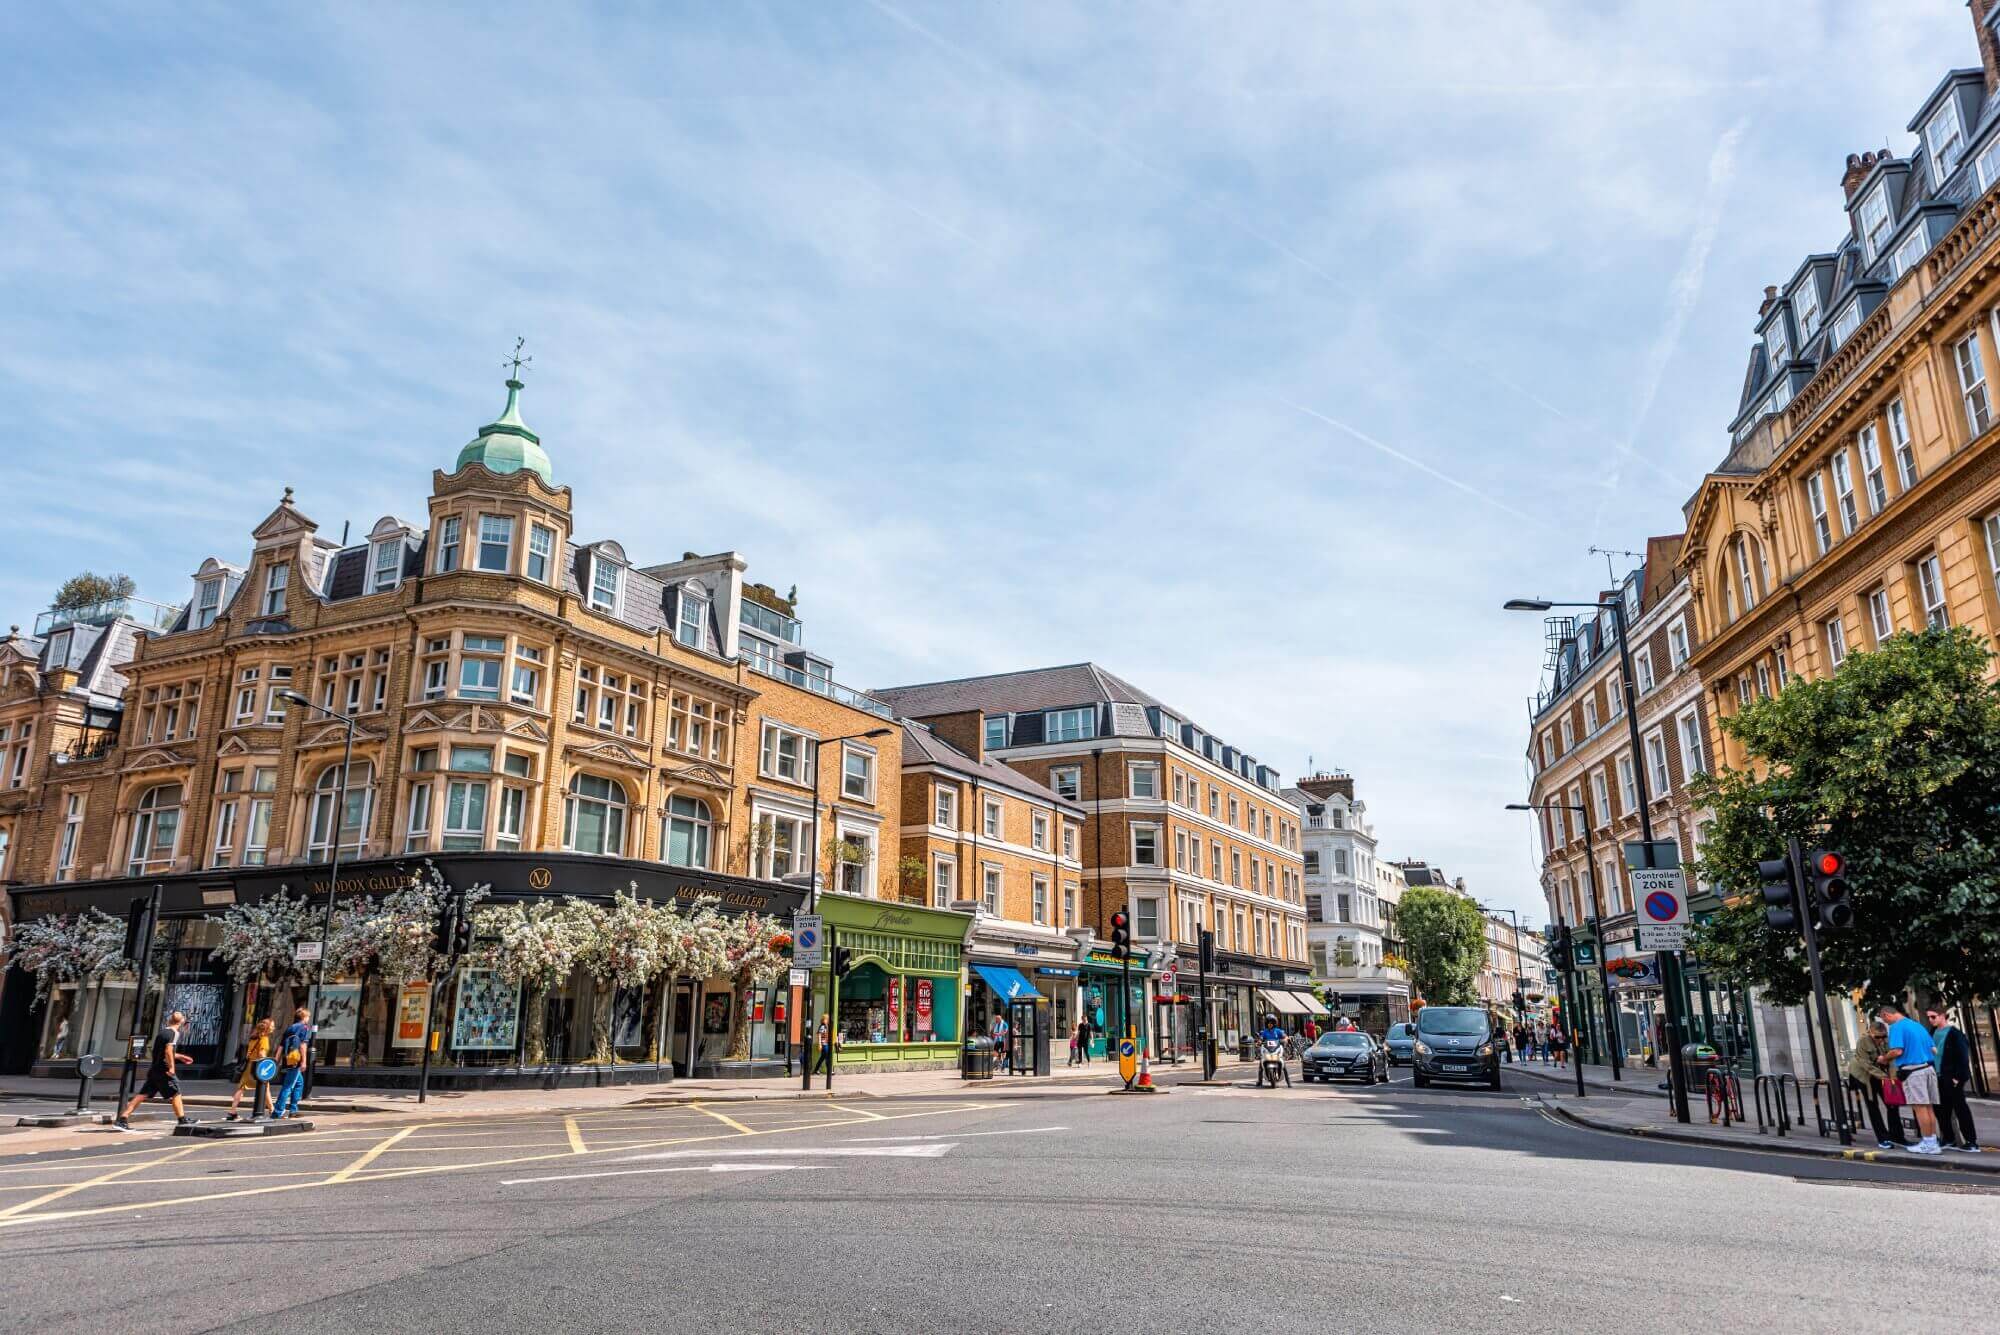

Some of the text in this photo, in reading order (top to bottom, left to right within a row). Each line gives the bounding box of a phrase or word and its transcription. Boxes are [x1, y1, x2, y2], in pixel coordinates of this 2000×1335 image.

[1635, 872, 1680, 880] Controlled
[1643, 881, 1674, 889] ZONE
[726, 893, 769, 908] GALLERY
[919, 988, 931, 997] BIG
[919, 998, 931, 1006] SALE
